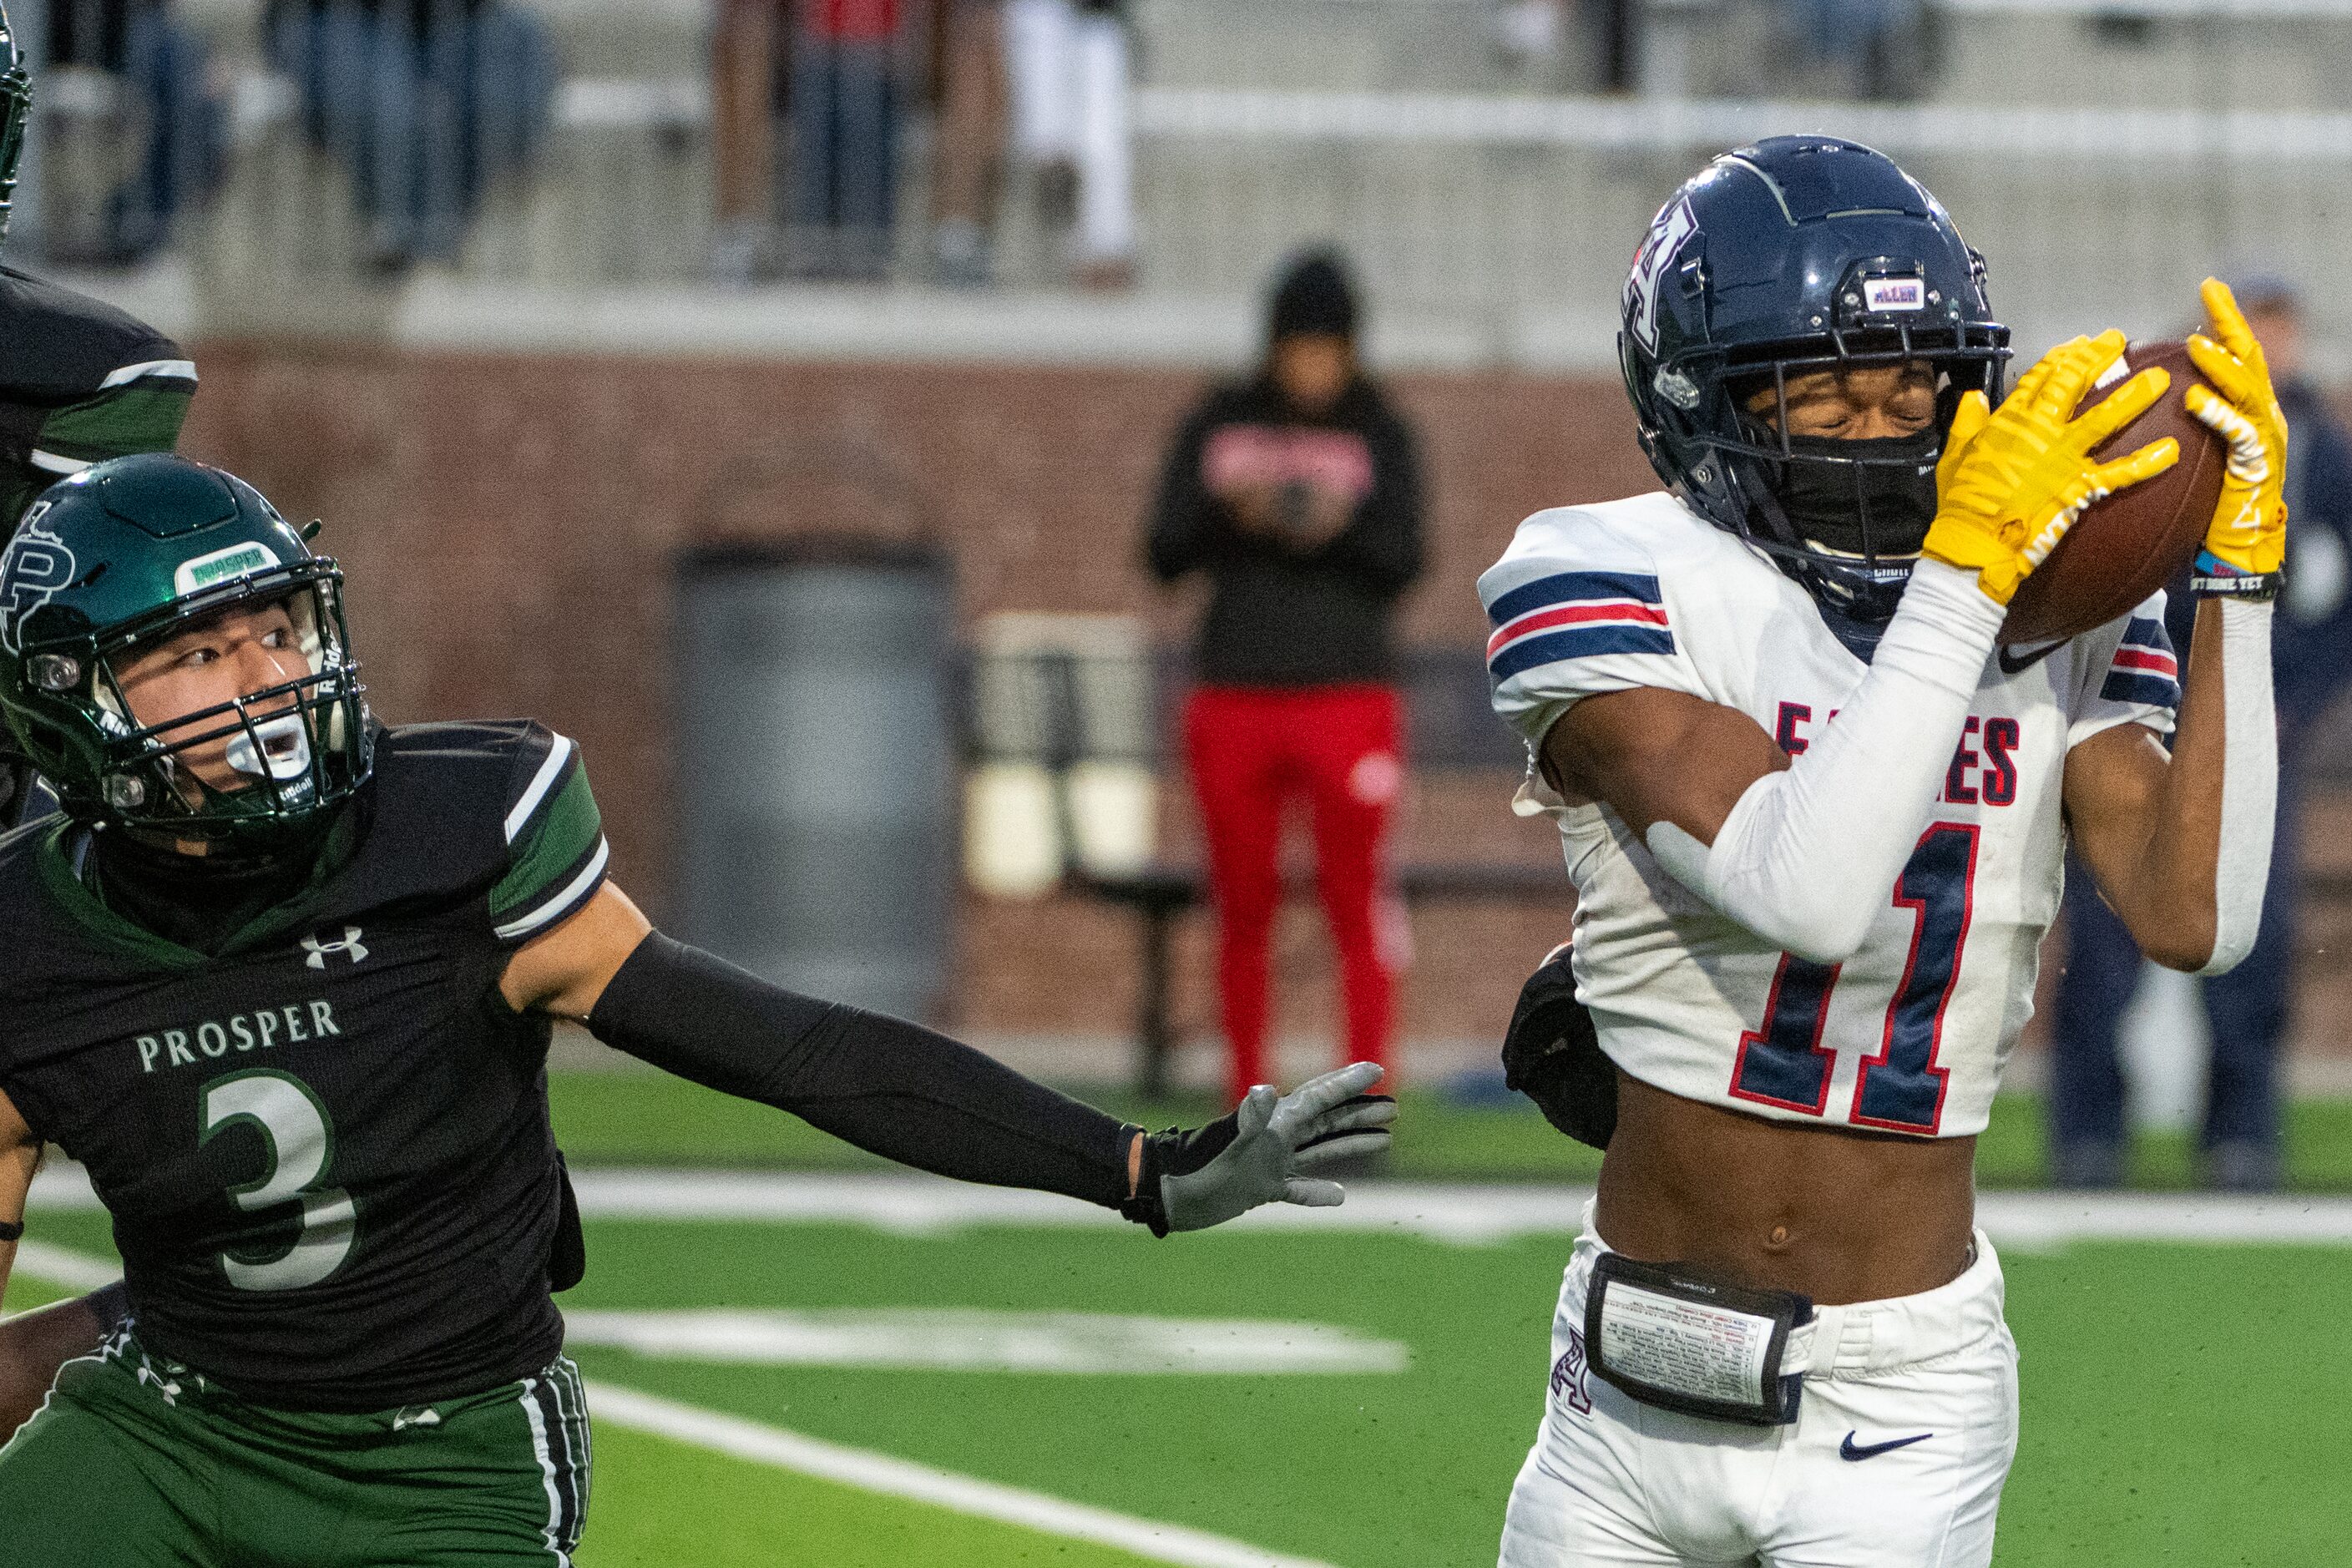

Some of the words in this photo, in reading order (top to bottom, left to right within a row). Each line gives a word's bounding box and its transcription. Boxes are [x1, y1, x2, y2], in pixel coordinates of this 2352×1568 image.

[1776, 701, 2020, 807] EES
[136, 1000, 342, 1073] PROSPER
[1728, 822, 1981, 1136] 11
[200, 1067, 362, 1294] 3
